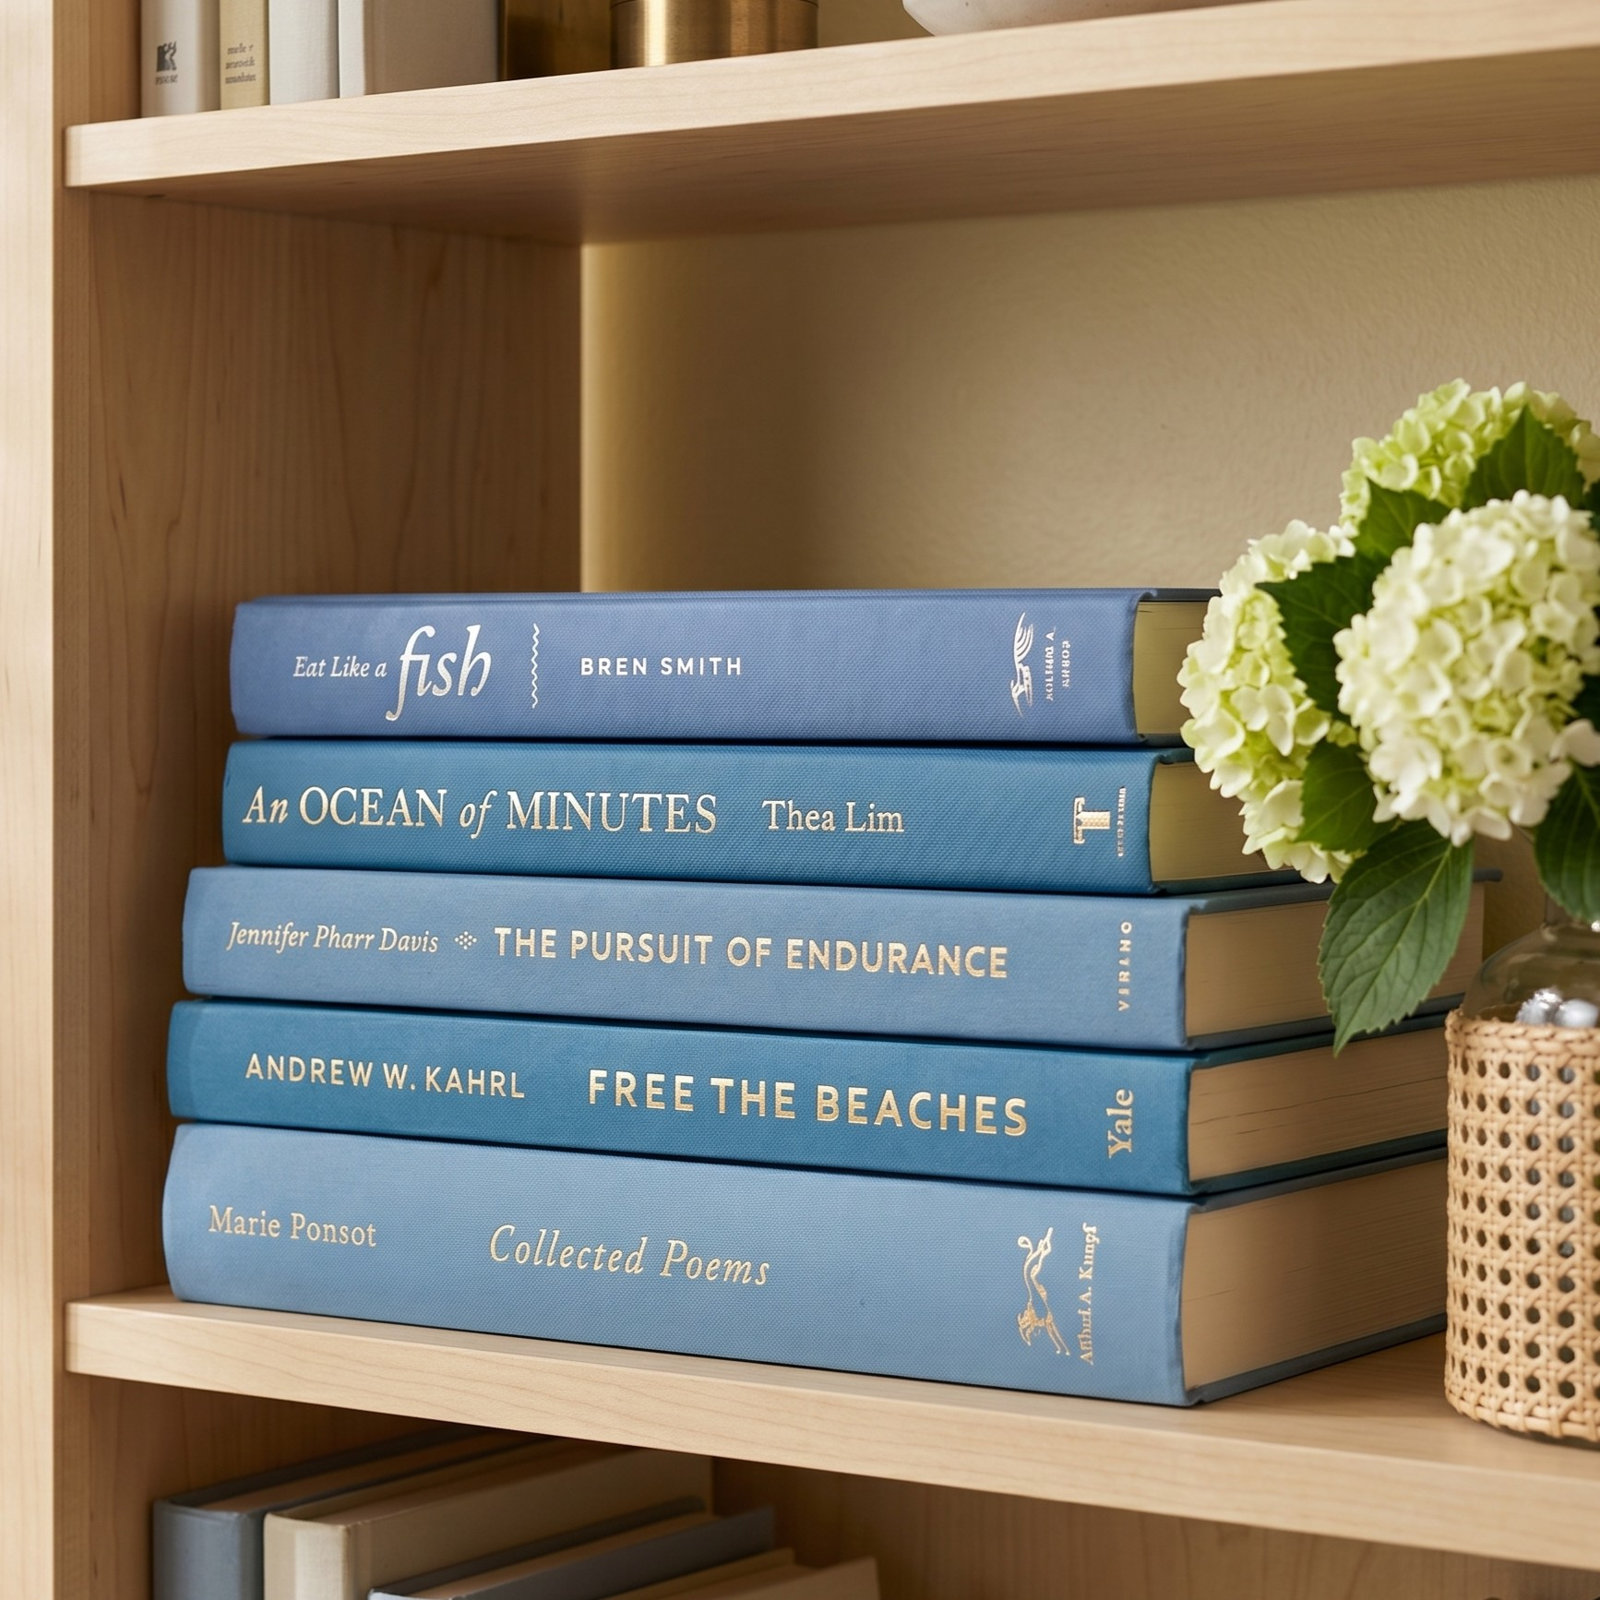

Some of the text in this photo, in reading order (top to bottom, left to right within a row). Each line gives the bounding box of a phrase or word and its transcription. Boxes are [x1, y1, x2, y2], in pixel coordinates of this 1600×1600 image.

[292, 624, 492, 721] Eat Like a fish
[580, 656, 741, 676] BREN SMITH
[242, 785, 717, 840] An OCEAN of MINUTES
[761, 799, 905, 833] Thea Lim
[226, 921, 439, 954] Jennifer Pharr Davis
[494, 927, 1008, 979] THE PURSUIT OF ENDURANCE
[245, 1053, 525, 1099] ANDREW W. KAHRL
[589, 1069, 1027, 1137] FREE THE BEACHES
[1105, 1089, 1134, 1159] Yale
[208, 1204, 377, 1248] Marie Ponsot
[490, 1224, 770, 1286] Collected Poems
